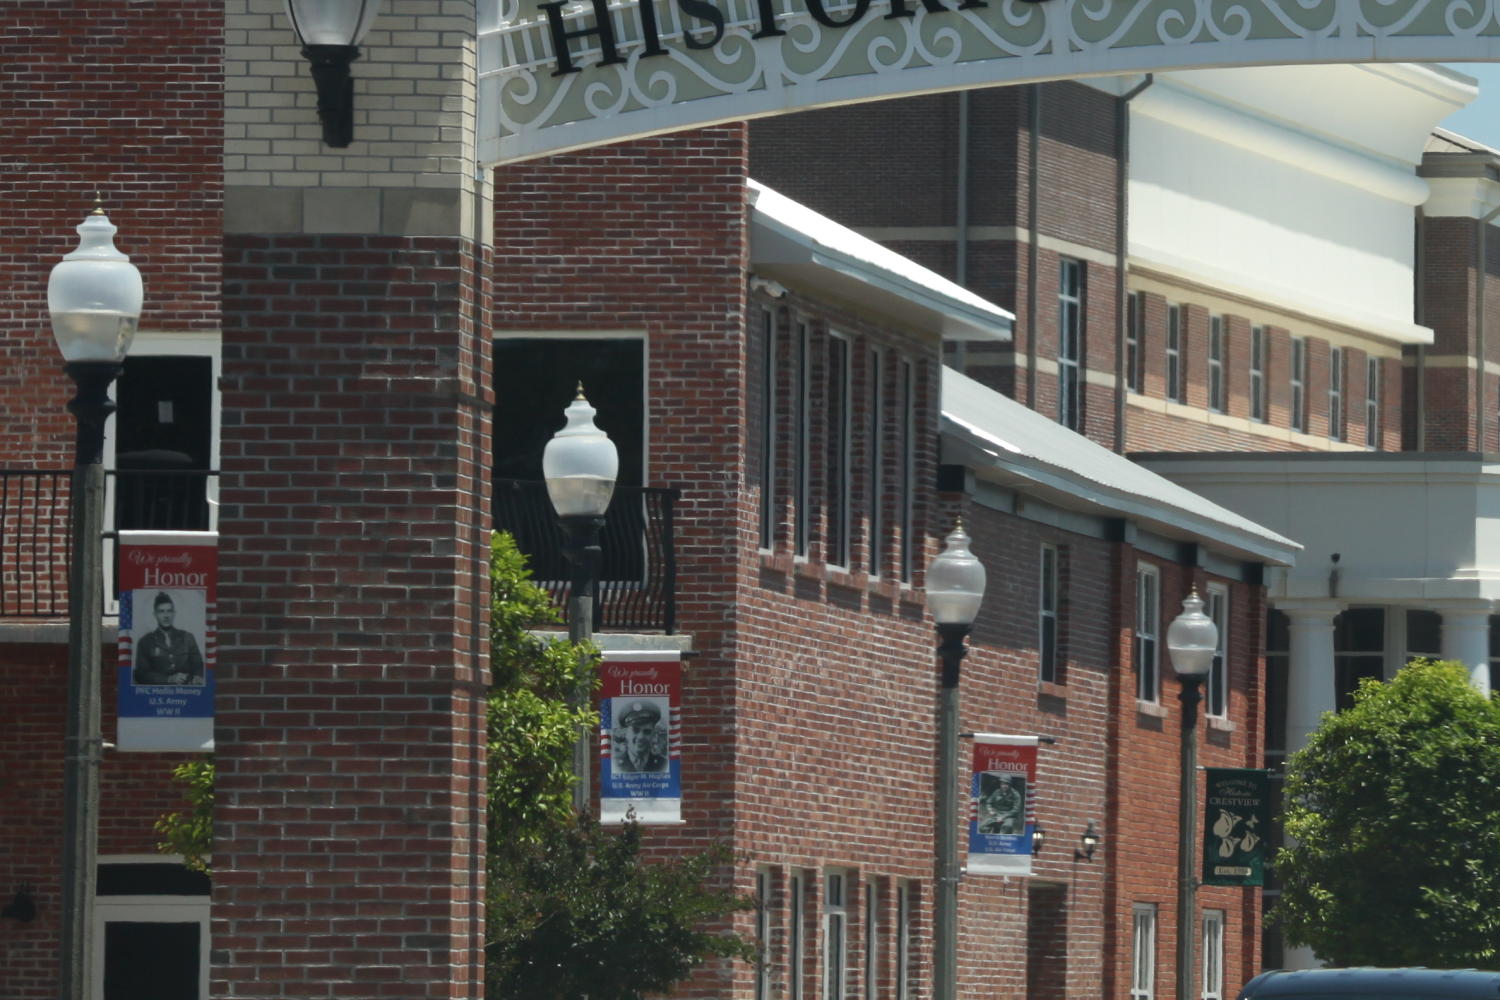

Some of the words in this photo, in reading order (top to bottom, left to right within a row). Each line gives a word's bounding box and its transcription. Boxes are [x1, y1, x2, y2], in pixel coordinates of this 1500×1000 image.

[144, 567, 208, 586] Honor
[620, 679, 671, 694] Honor
[987, 758, 1029, 771] Honor
[1209, 796, 1261, 807] CRESTVIEW
